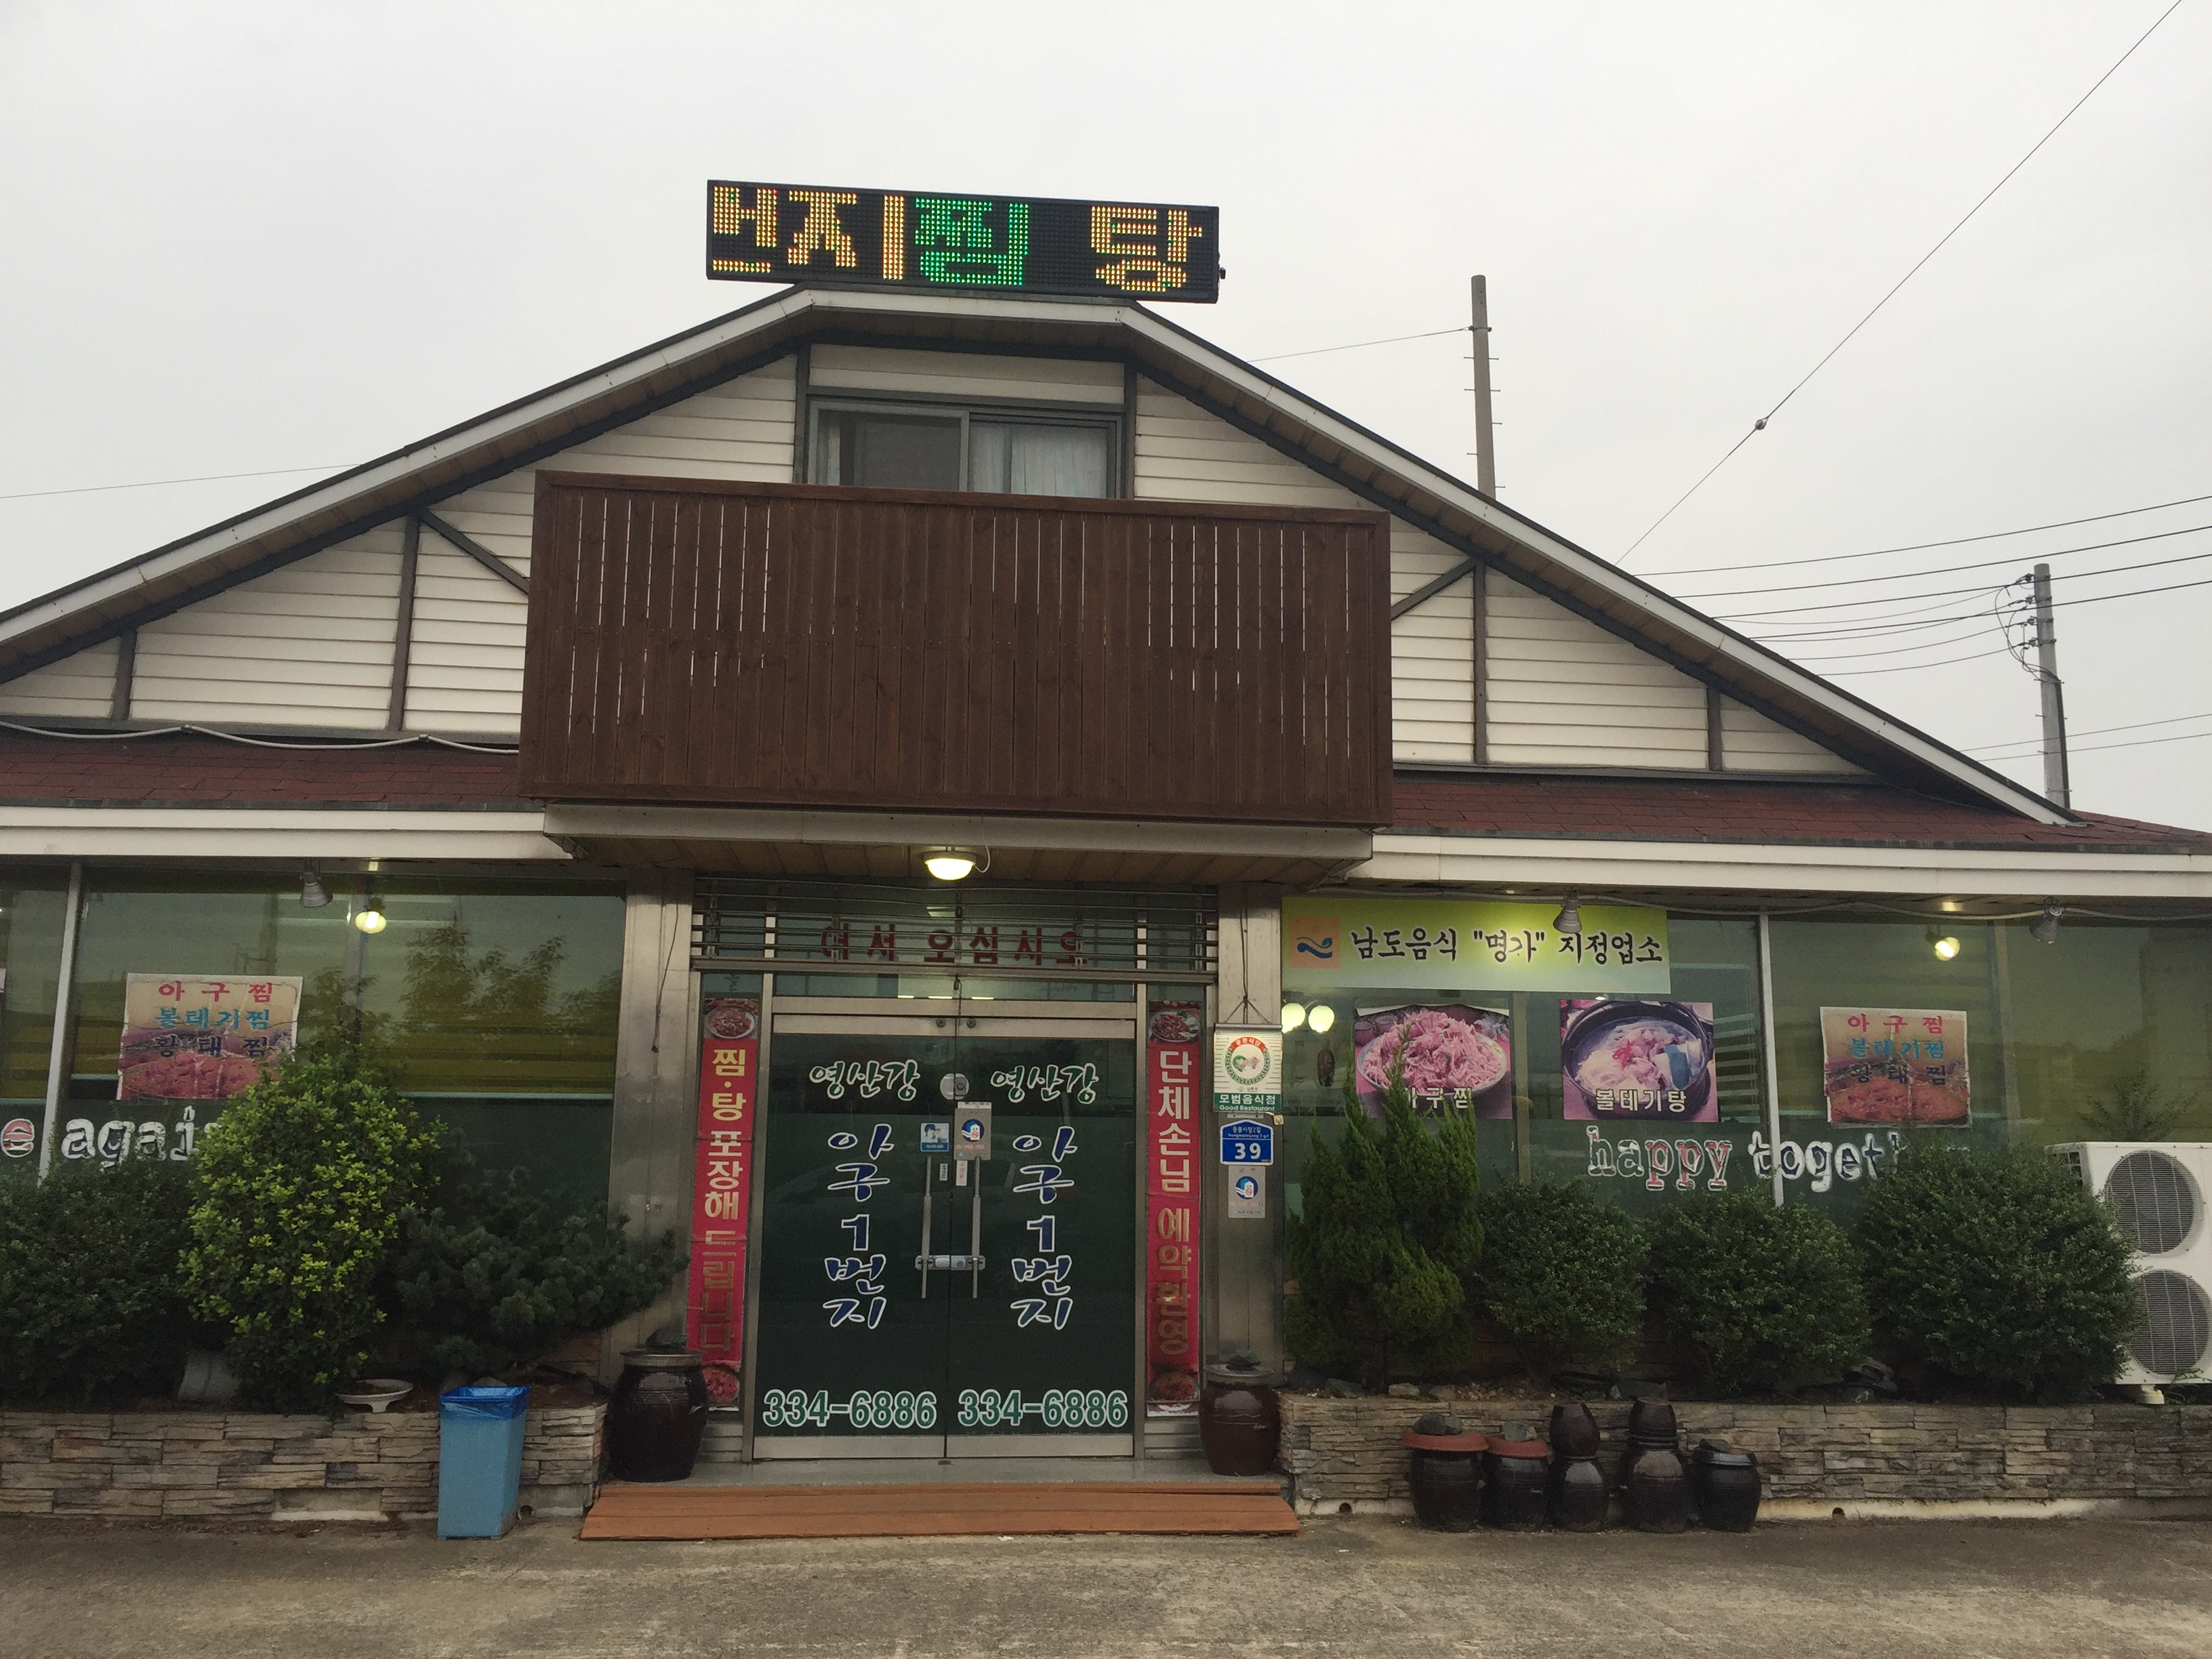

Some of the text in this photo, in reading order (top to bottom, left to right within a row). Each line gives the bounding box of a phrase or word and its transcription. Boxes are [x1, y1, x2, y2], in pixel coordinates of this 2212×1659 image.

[1090, 206, 1203, 291] 탕
[1351, 926, 1457, 962] 남도음식
[1558, 932, 1663, 965] 지정업소
[809, 1059, 920, 1099] 영산강
[991, 1063, 1099, 1103] 영산강
[1219, 1094, 1275, 1105] 모범음식점
[1158, 1050, 1191, 1193] 단체손님
[1235, 1143, 1261, 1160] 39
[1586, 1126, 1732, 1191] happy
[763, 1389, 937, 1428] 334-6886
[958, 1390, 1128, 1427] 334-6886
